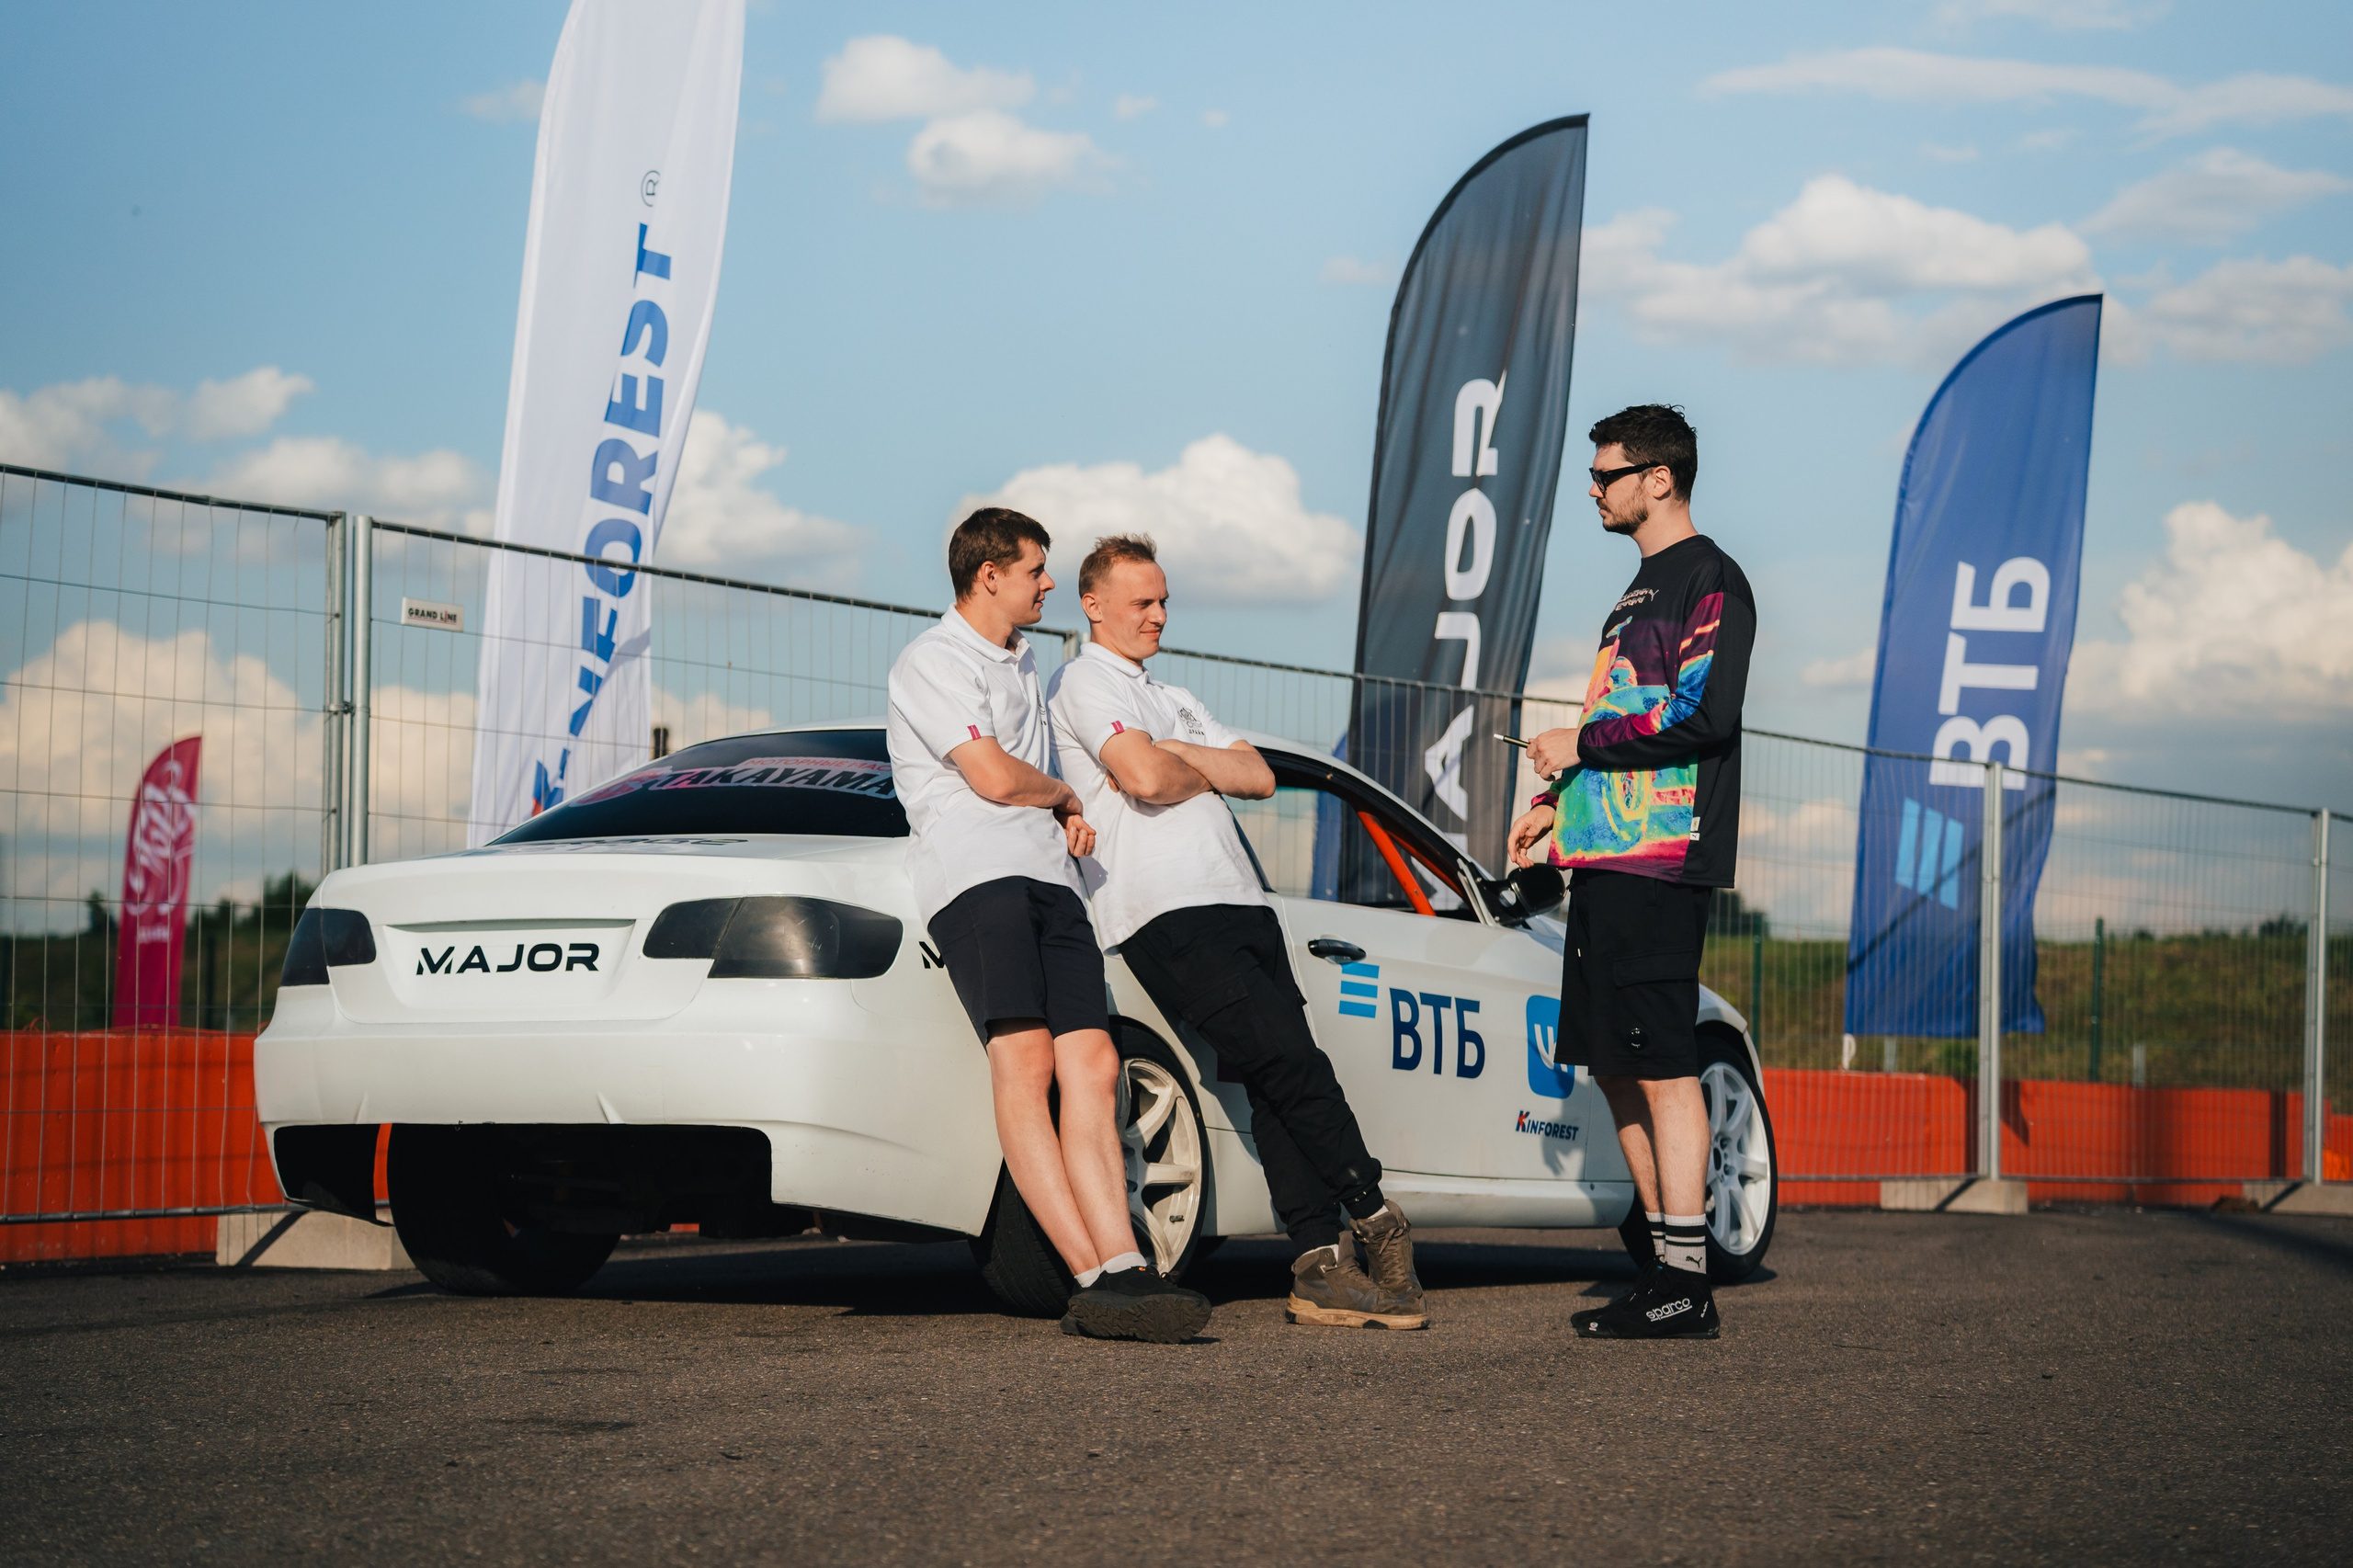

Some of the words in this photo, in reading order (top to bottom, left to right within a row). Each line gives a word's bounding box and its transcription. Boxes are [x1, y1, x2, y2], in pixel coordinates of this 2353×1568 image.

[408, 608, 438, 619] GRAND
[440, 610, 458, 624] LINE
[1928, 555, 2052, 791] ВТБ
[745, 758, 846, 768] МОТОРНЫЕ
[847, 761, 892, 773] МАС
[656, 767, 896, 796] TAKAYAMA
[415, 942, 600, 976] MAJOR
[1389, 987, 1486, 1079] ВТБ
[1516, 1109, 1580, 1142] KINFOREST
[1645, 1297, 1694, 1321] sparco
